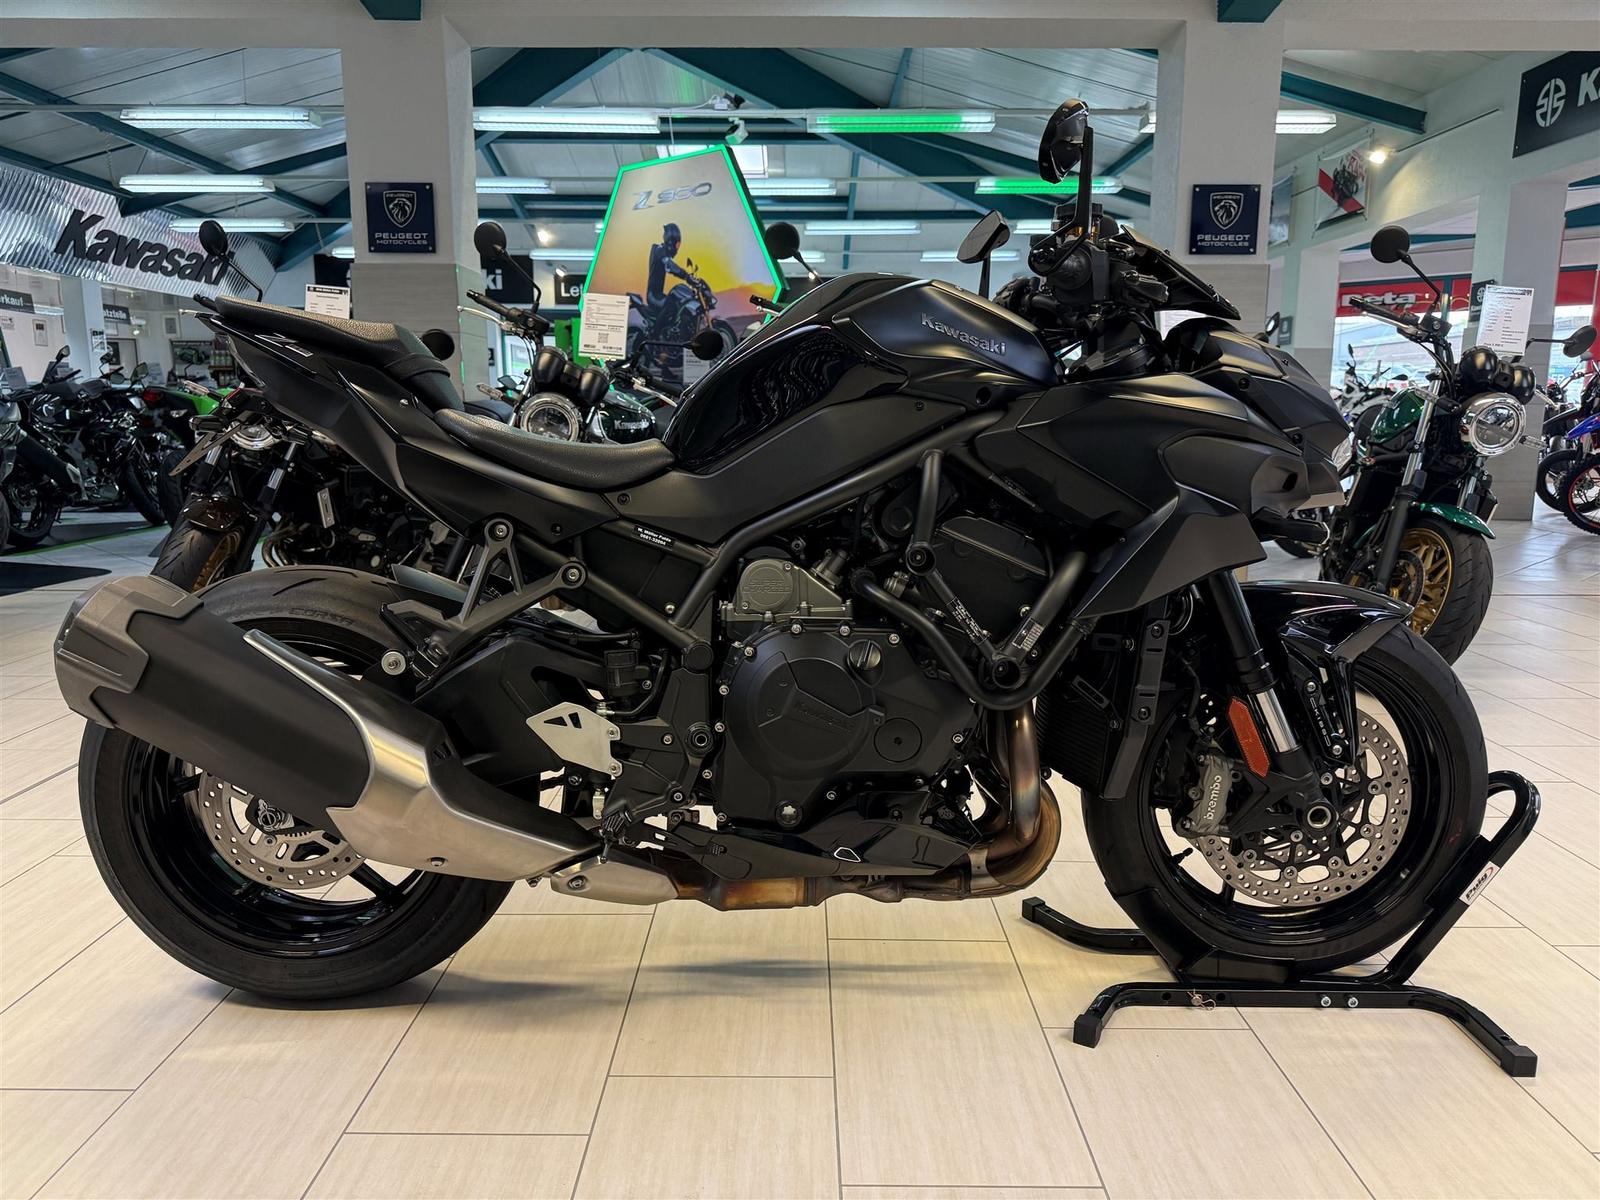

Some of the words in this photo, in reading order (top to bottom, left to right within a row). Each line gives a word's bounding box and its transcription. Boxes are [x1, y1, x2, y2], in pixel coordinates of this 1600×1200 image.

[54, 208, 236, 286] Kawasaki
[921, 312, 1006, 355] Kawasaki
[1203, 775, 1222, 820] brembo
